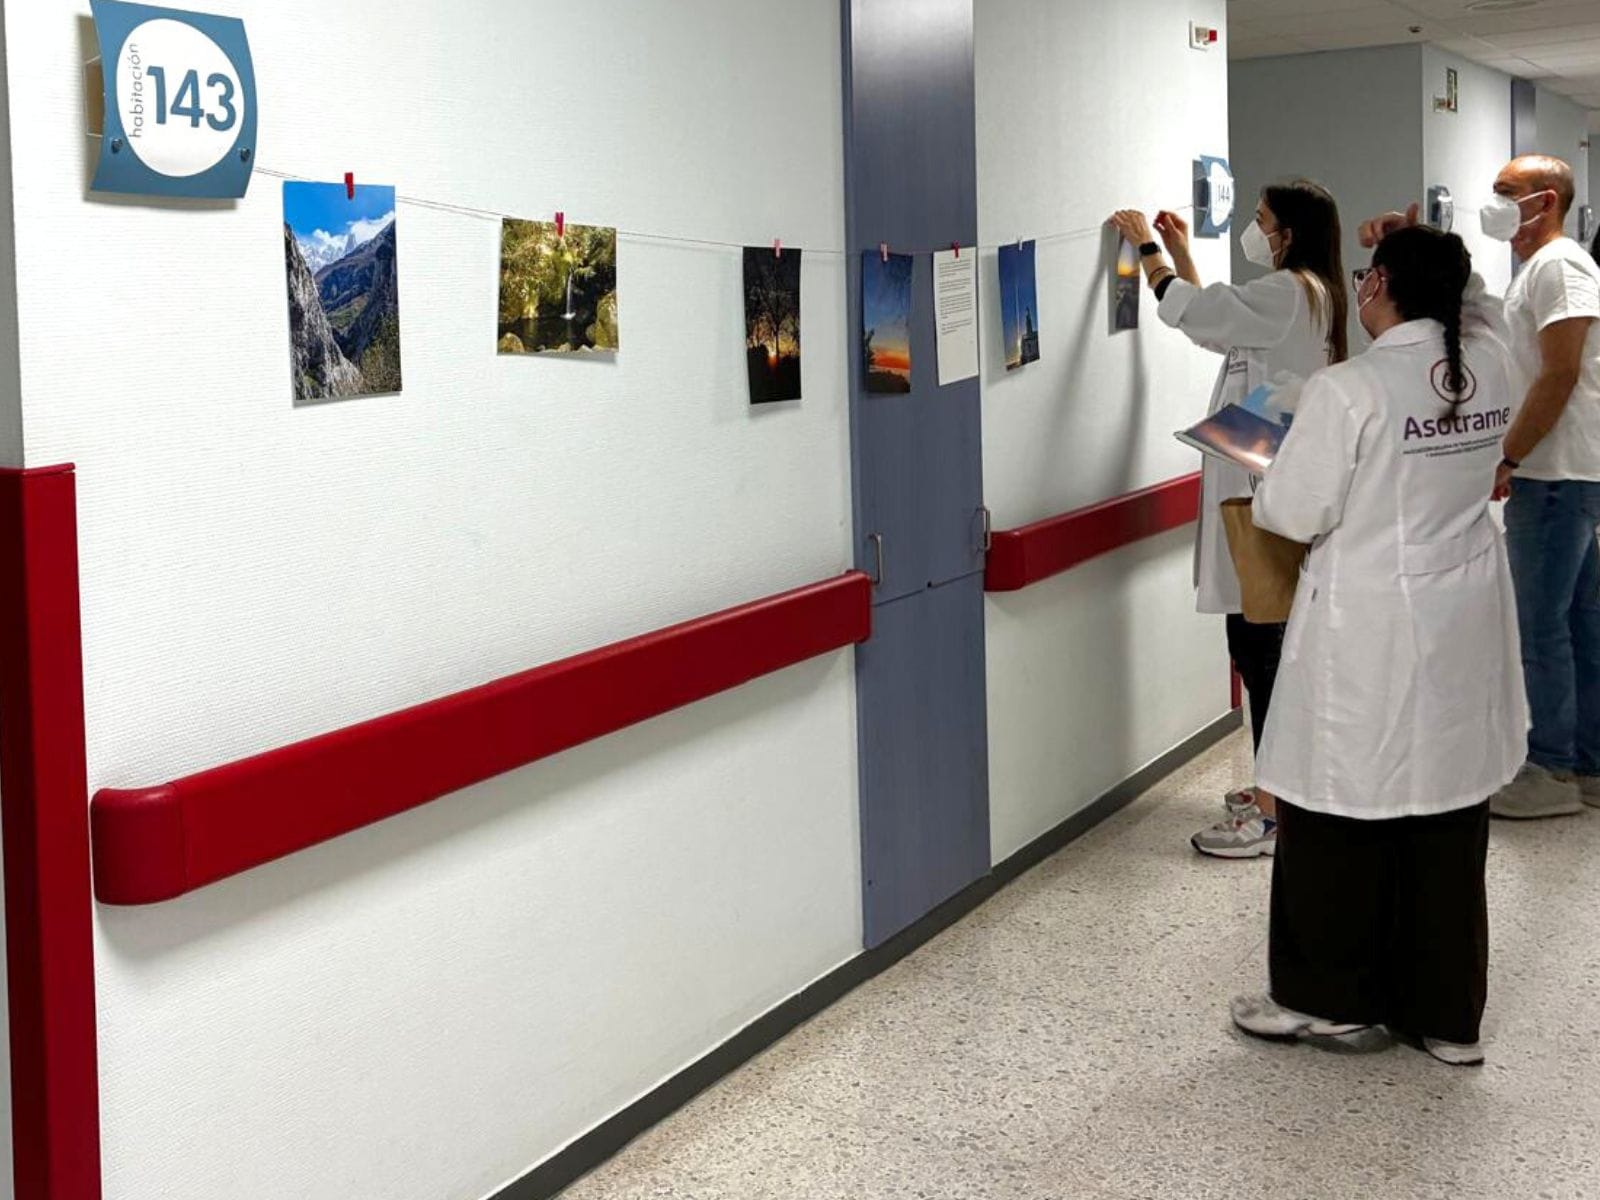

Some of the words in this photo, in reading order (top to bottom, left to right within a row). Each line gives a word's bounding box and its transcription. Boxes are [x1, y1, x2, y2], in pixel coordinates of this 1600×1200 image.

[127, 43, 144, 138] habitación
[146, 65, 237, 132] 143
[1218, 183, 1231, 202] 144
